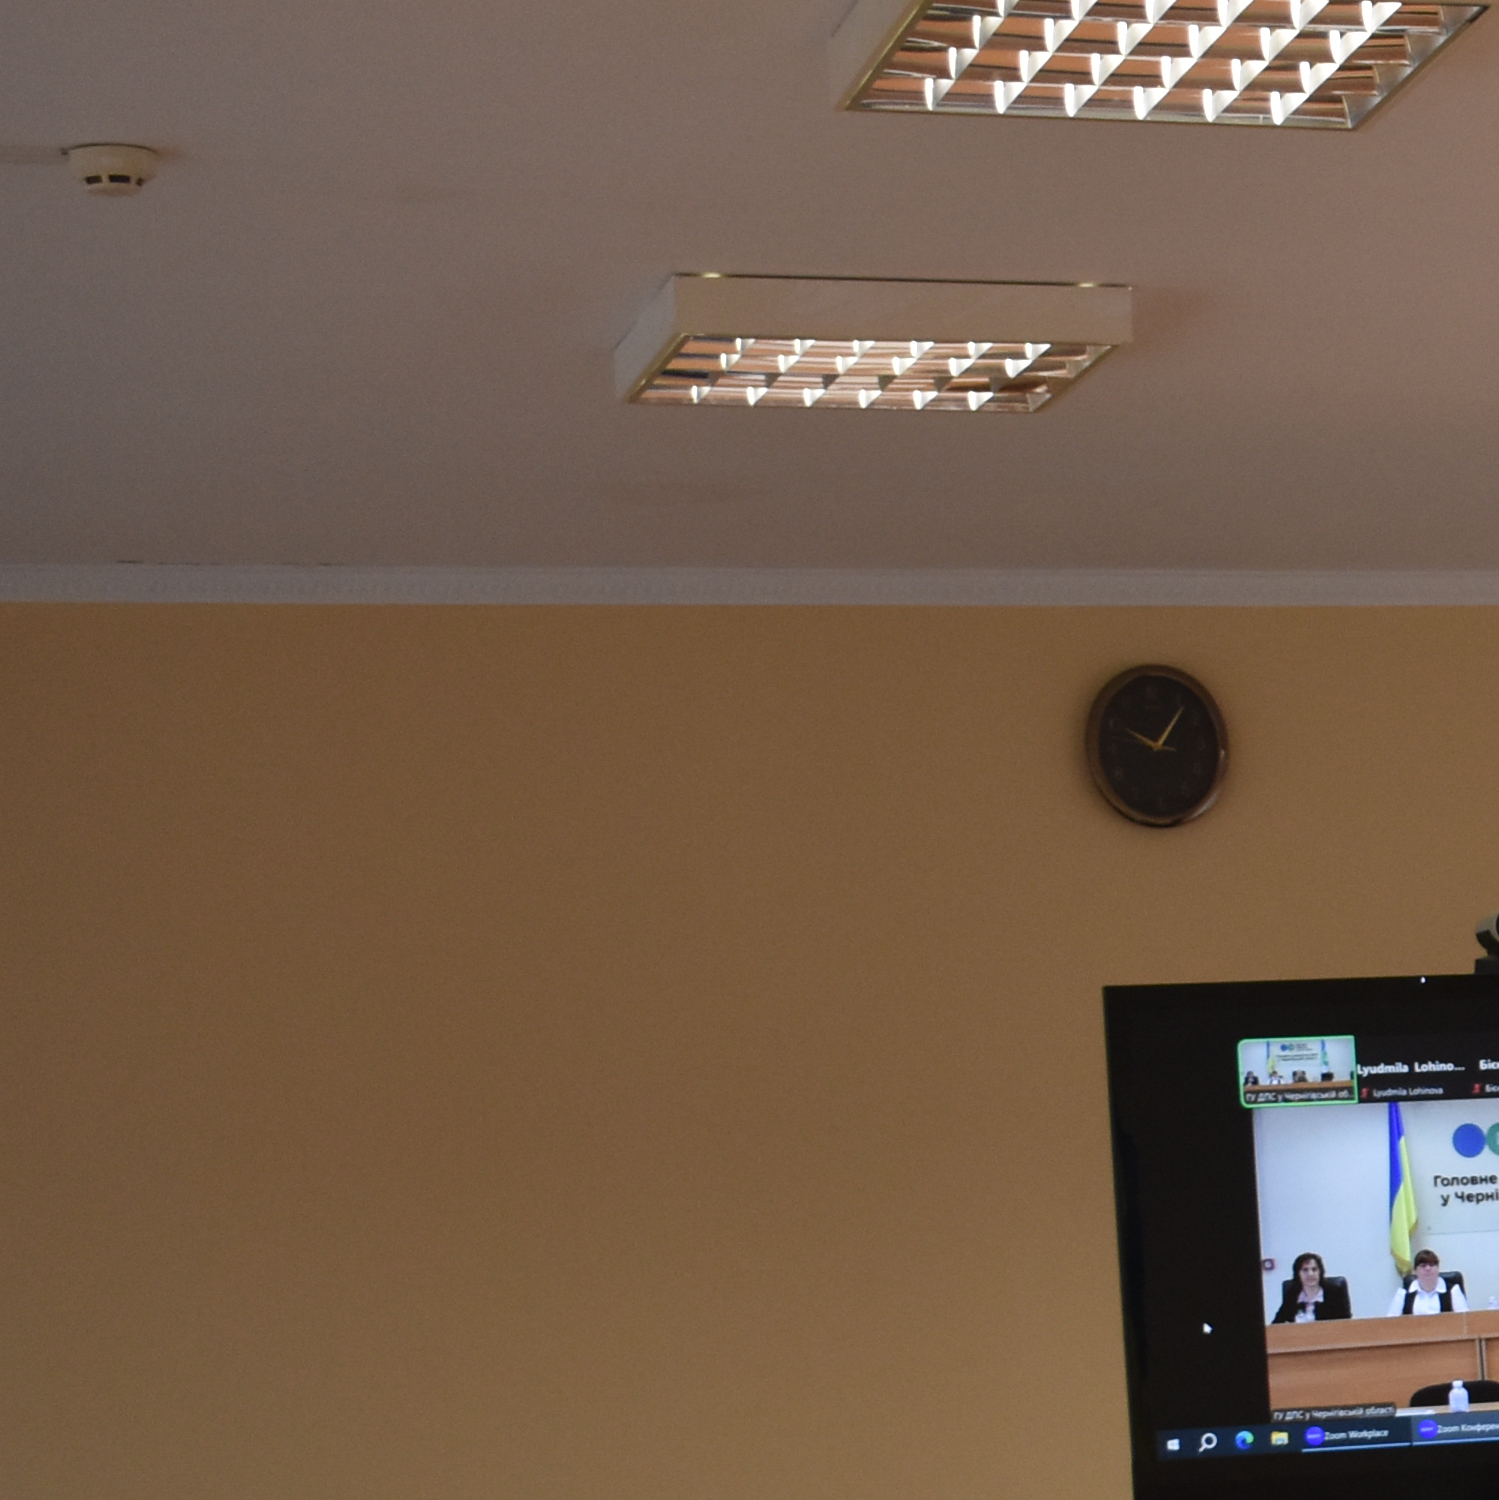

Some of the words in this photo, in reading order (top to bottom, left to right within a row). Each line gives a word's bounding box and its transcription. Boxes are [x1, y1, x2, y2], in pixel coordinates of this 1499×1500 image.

[1357, 1062, 1409, 1077] Lyudmila
[1434, 1174, 1498, 1187] Головне
[1441, 1193, 1450, 1207] у
[1324, 1430, 1347, 1440] Zoom
[1349, 1428, 1389, 1439] Workplace
